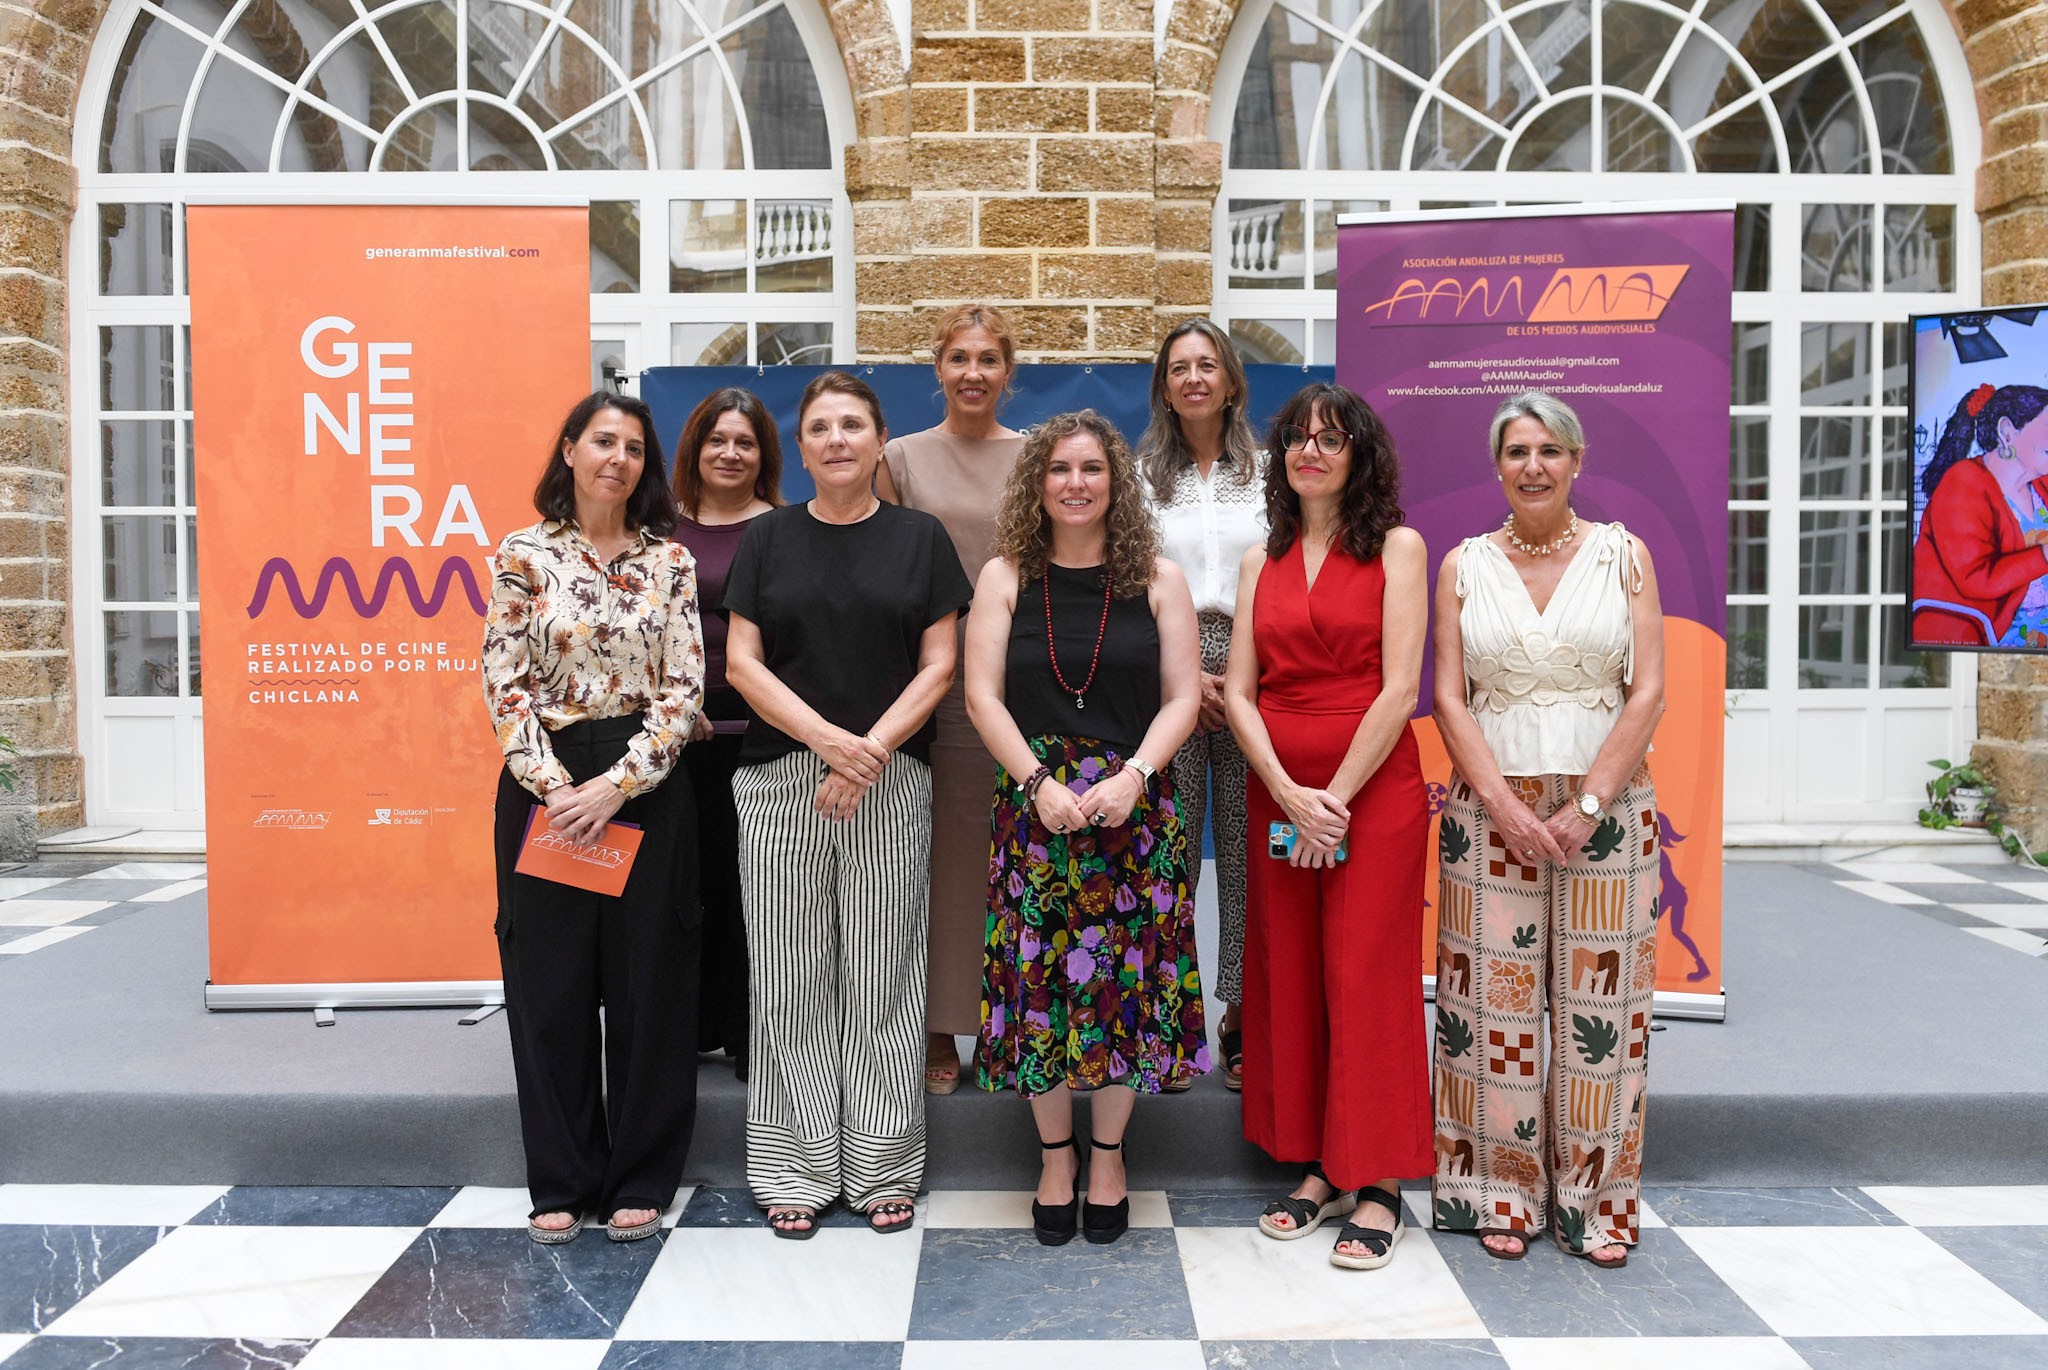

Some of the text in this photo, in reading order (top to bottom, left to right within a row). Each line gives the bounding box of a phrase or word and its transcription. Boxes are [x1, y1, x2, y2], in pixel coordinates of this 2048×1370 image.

[365, 245, 540, 260] generammafestival.com
[1402, 253, 1565, 268] ASOCIACIÓN ANDALUZA DE MUJERES
[1506, 323, 1657, 336] DE LOS MEDIOS AUDIOVISUALES
[1428, 356, 1620, 369] aammamujeresaudiovisual@gmail.com
[1481, 369, 1565, 382] @AAMMAaudiov
[1387, 382, 1664, 397] www.facebook.com/AAMMAmujeresaudiovisualandaluz
[247, 641, 447, 657] FESTIVAL DE CINE
[248, 659, 478, 674] REALIZADO POR MUJ
[248, 690, 360, 704] CHICLANA
[393, 808, 429, 816] Diputación
[393, 817, 423, 825] de Cádiz
